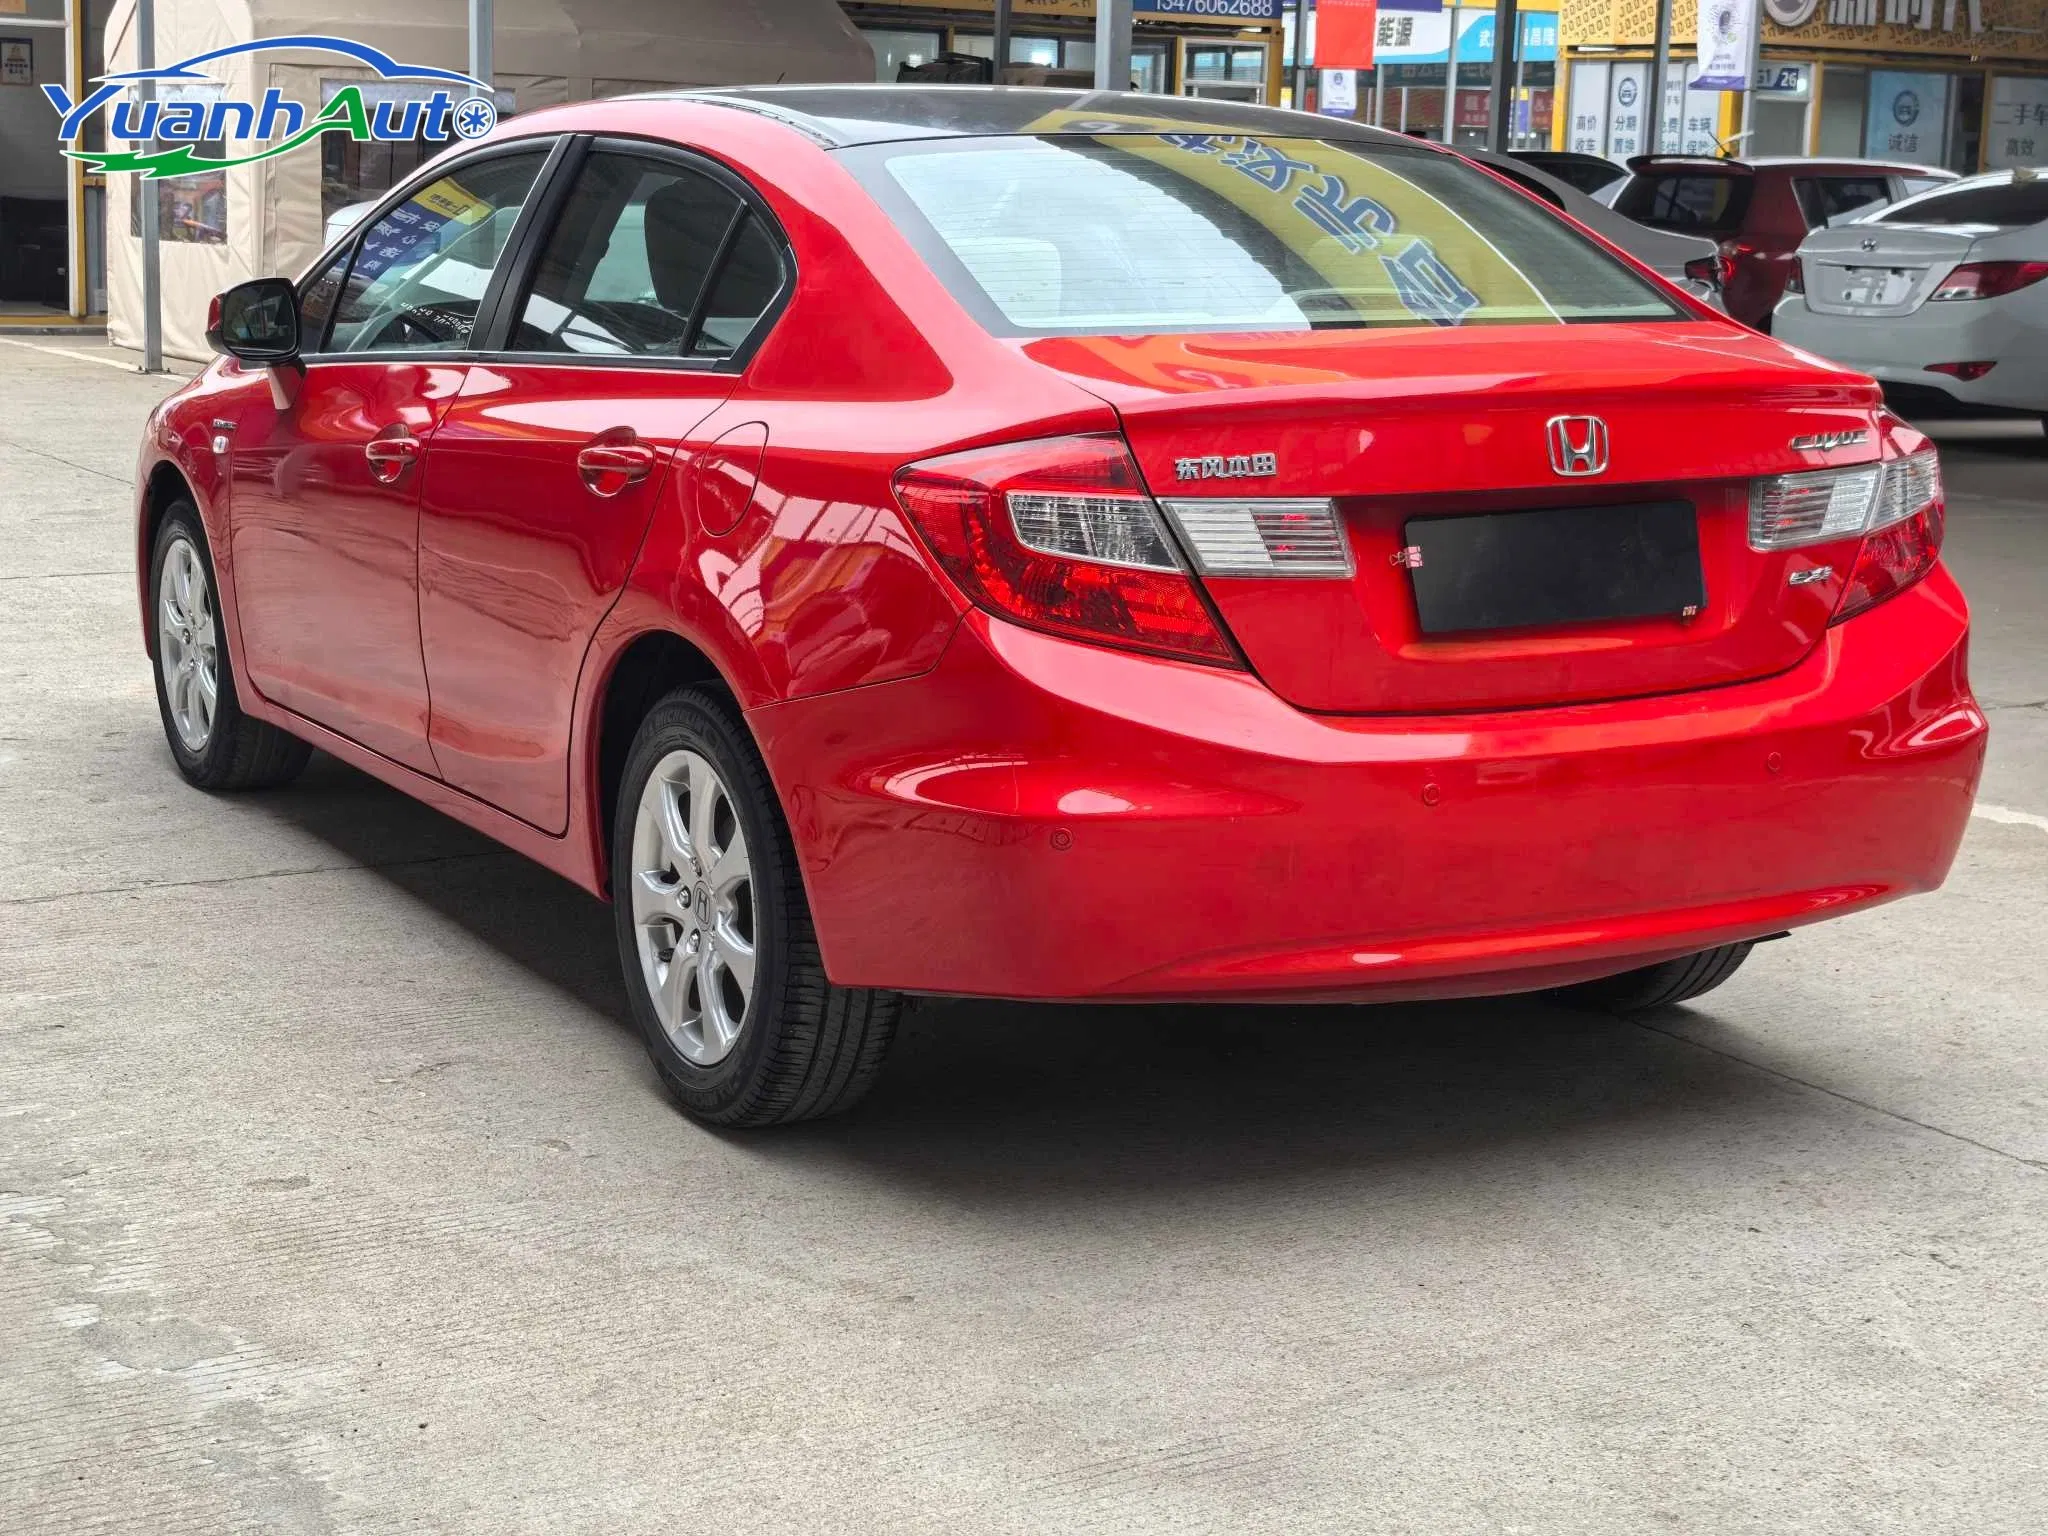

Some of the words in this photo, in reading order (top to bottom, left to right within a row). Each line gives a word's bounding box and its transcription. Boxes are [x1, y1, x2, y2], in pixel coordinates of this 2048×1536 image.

[1376, 16, 1413, 47] 能源
[1780, 71, 1797, 87] 26
[1576, 115, 1597, 131] 高价
[1993, 102, 2048, 126] 二手车
[1790, 429, 1870, 452] CIVIC
[1174, 452, 1277, 481] 东风本田
